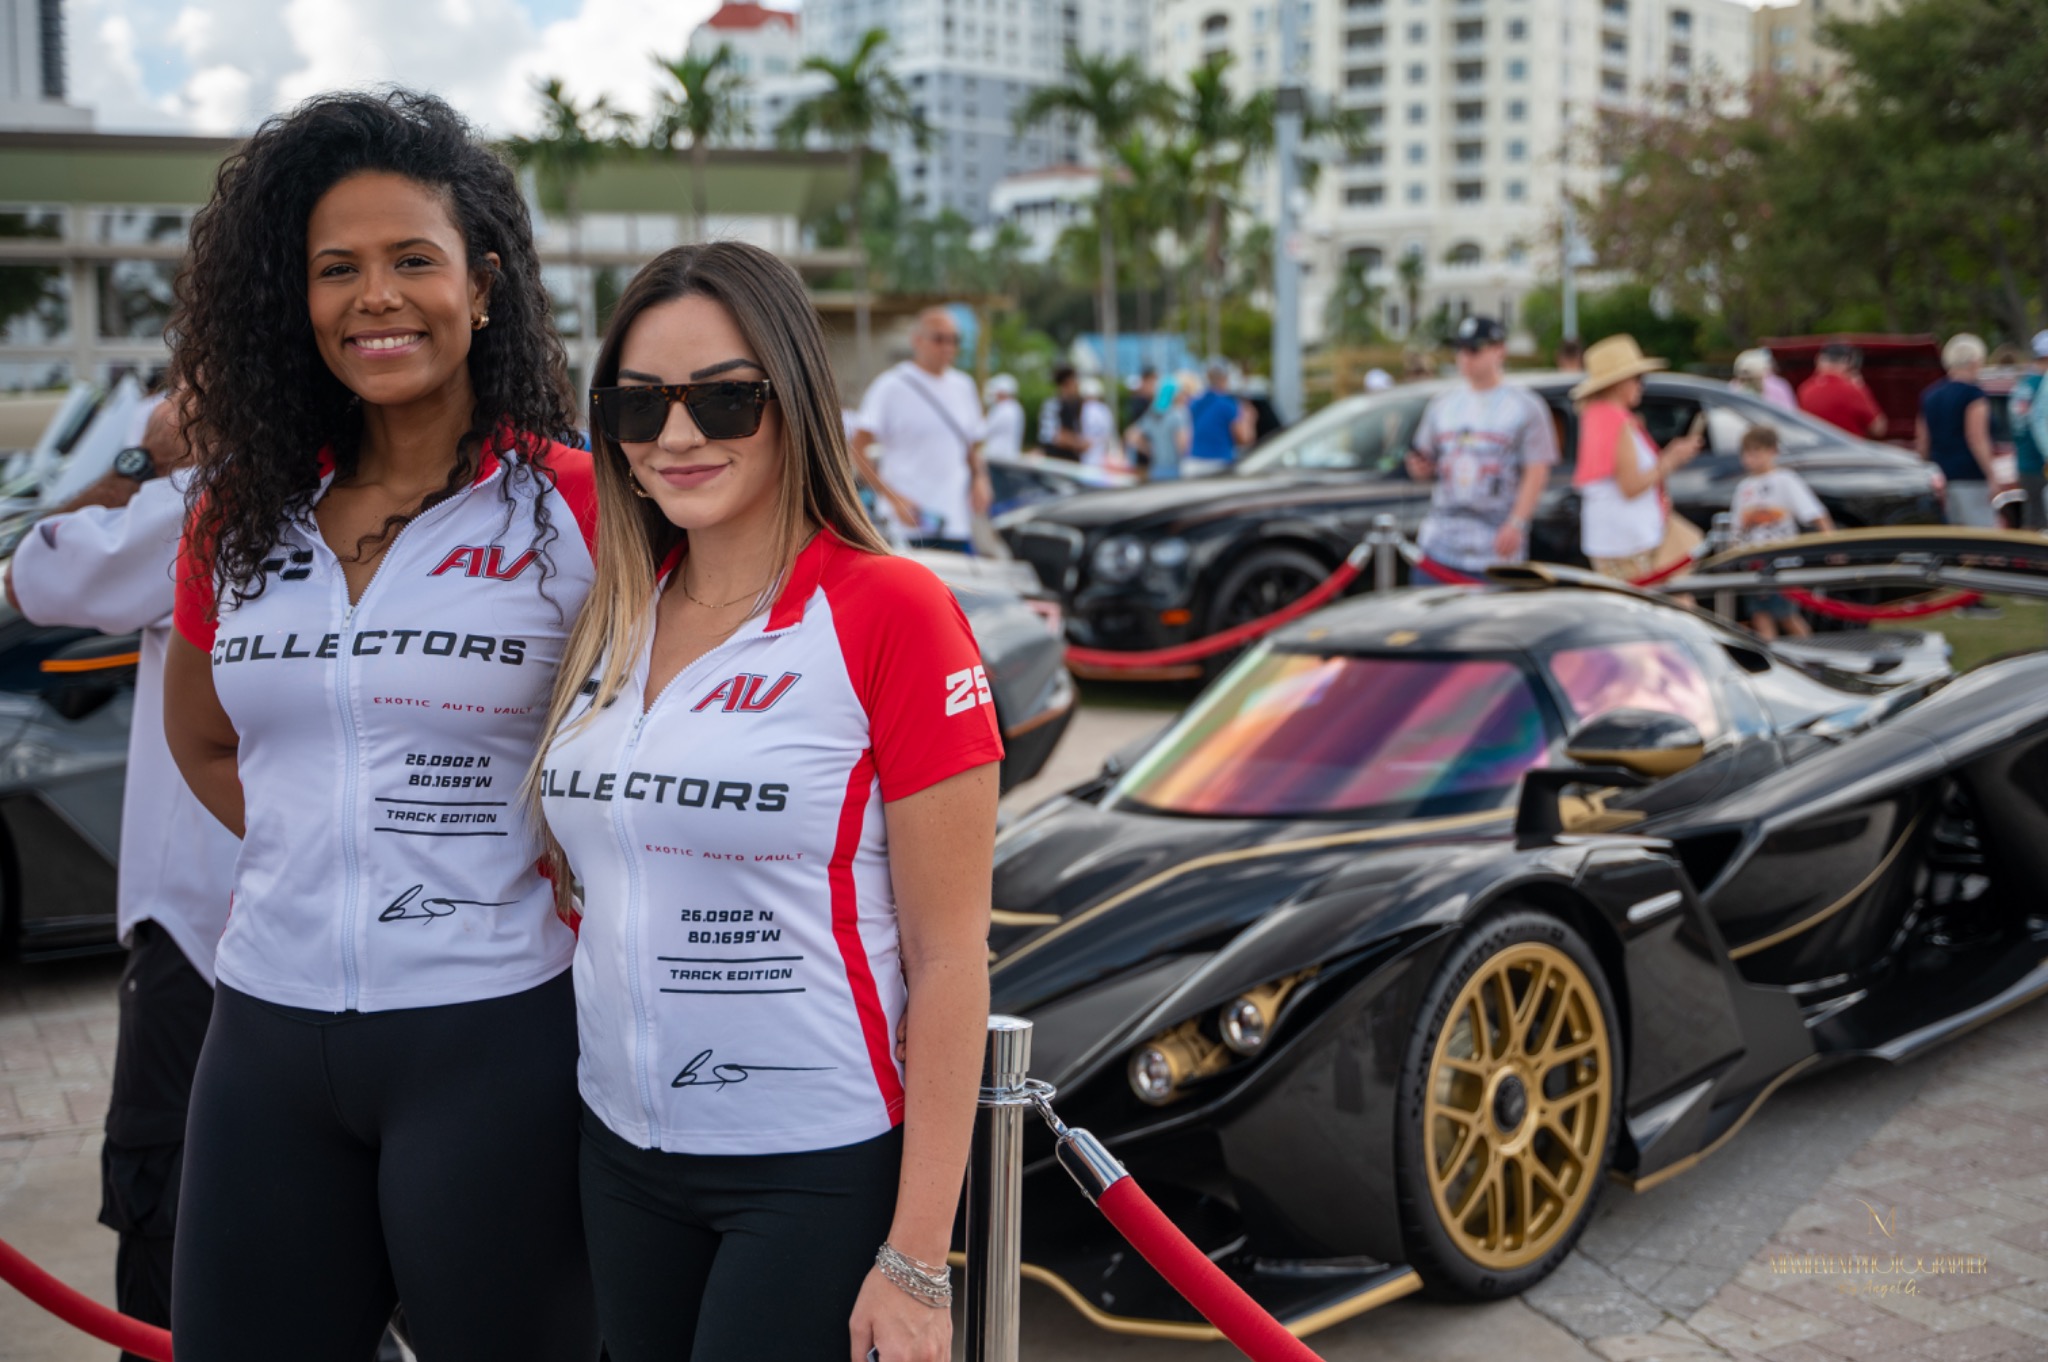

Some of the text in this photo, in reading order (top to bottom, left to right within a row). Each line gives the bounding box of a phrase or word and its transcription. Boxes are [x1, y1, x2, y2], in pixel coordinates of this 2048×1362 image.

[212, 630, 526, 666] COLLECTORS
[373, 696, 534, 715] EXOTIC AUTO VAULT
[405, 753, 491, 768] 26.0902 N
[386, 809, 497, 823] TRACK EDITION
[645, 844, 804, 862] EXOTIC AUTO VAULT
[681, 909, 774, 923] 26.0902 N
[670, 968, 793, 981] TRACK EDITION
